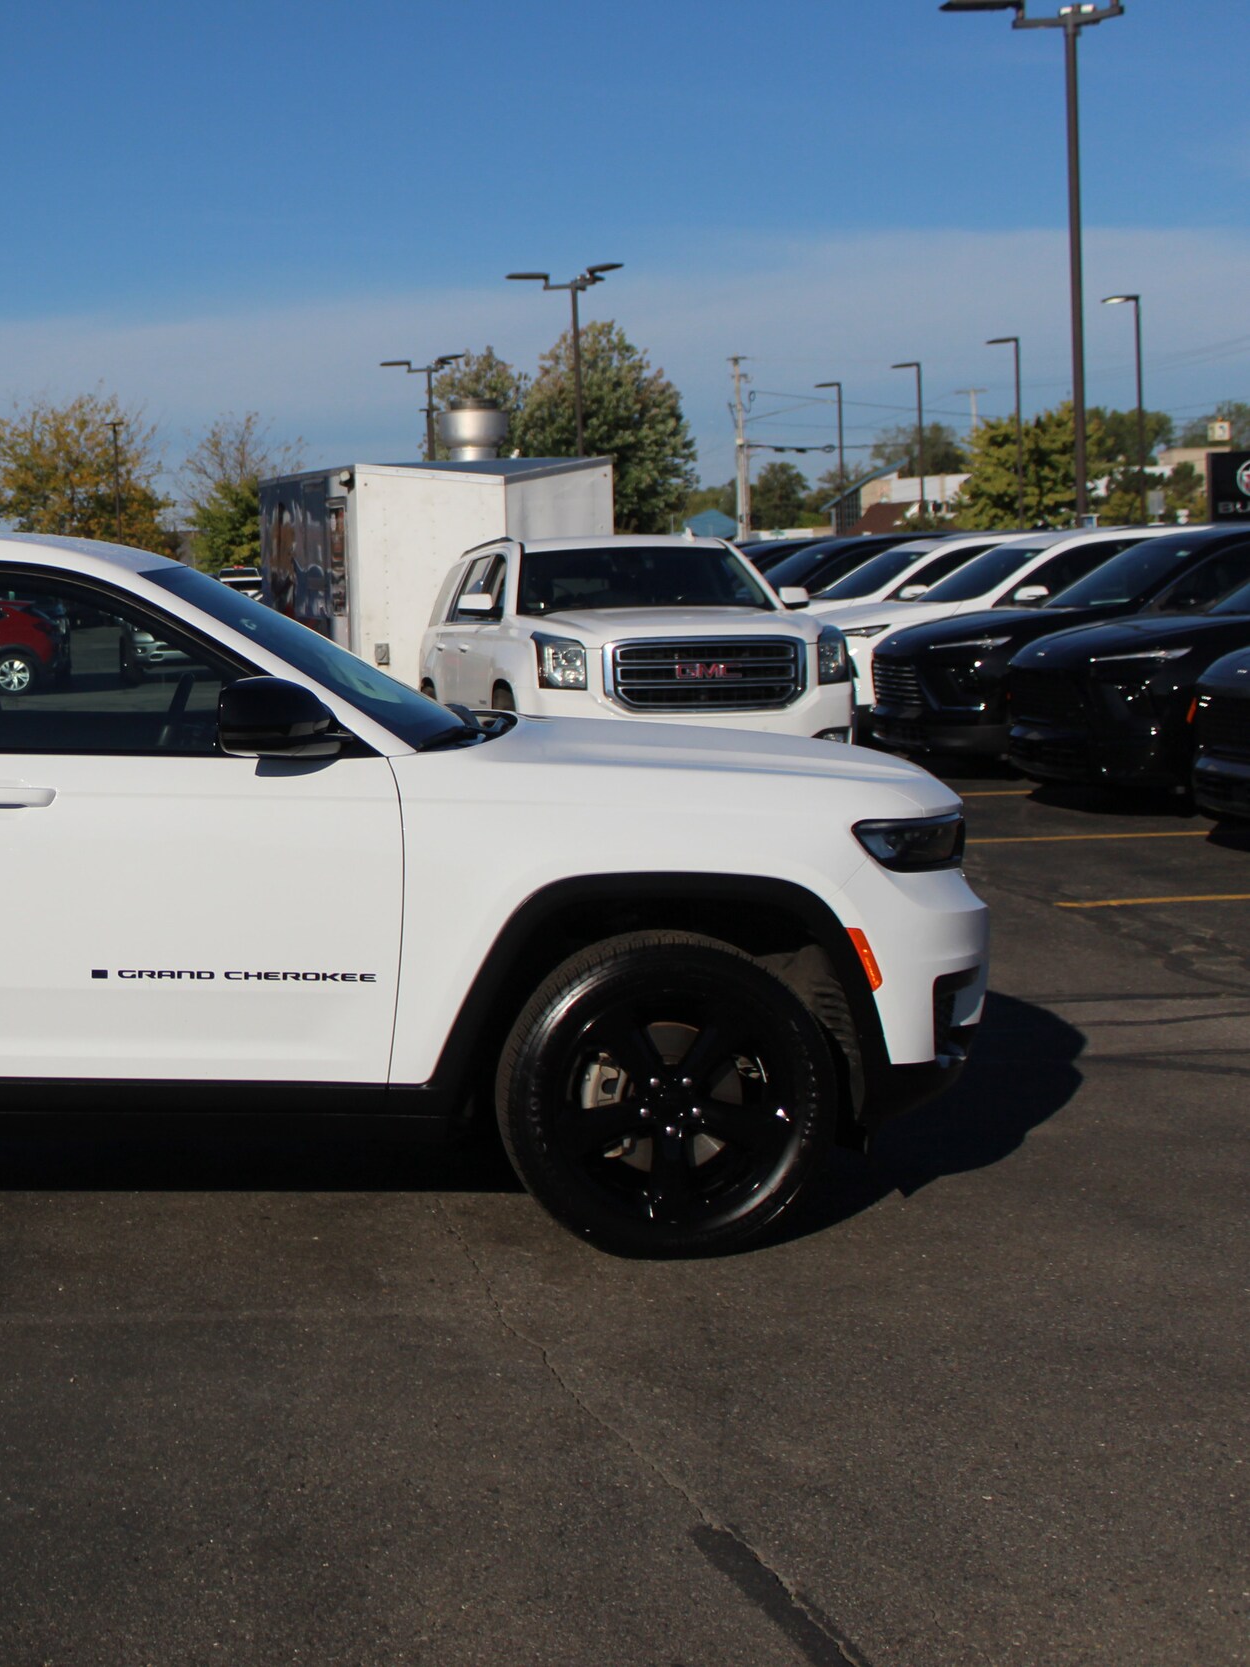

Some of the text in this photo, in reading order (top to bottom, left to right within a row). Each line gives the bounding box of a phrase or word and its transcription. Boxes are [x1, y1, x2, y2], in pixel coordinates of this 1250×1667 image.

[675, 663, 742, 679] GMC
[118, 969, 376, 983] GRAND CHEROKEE
